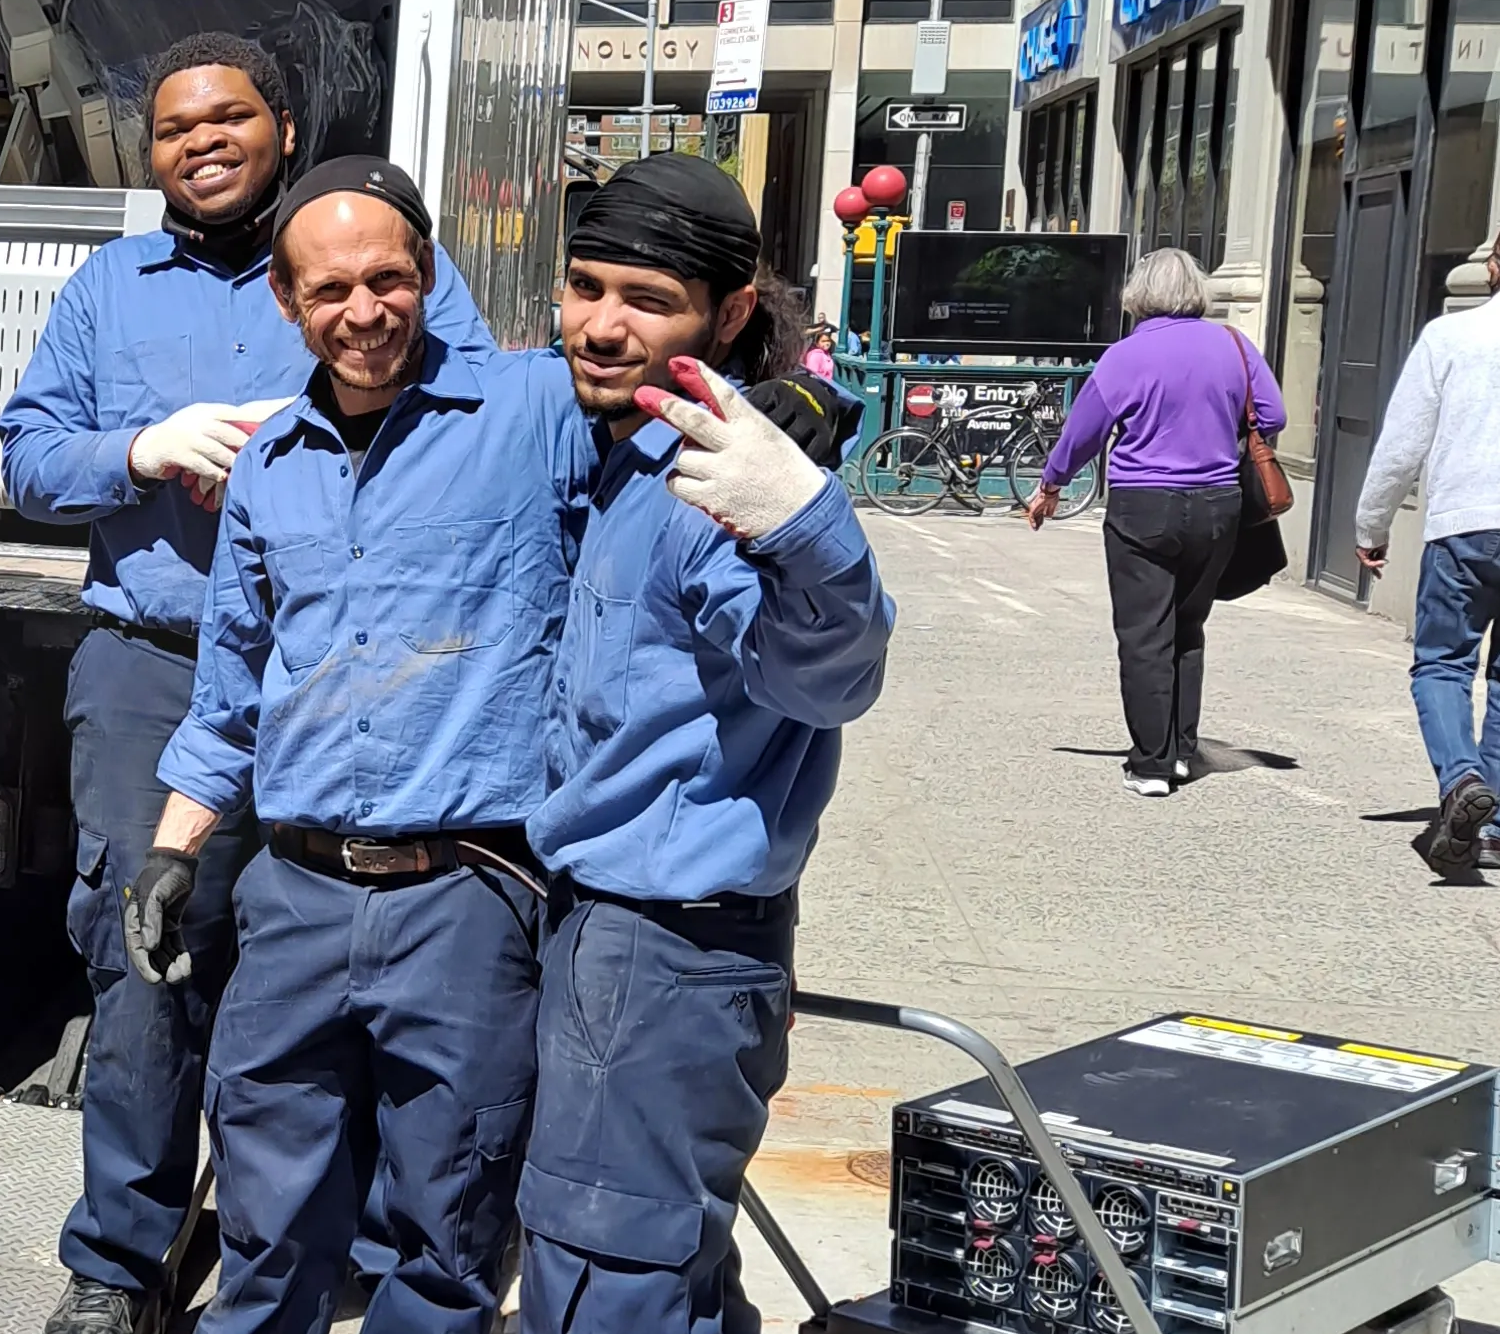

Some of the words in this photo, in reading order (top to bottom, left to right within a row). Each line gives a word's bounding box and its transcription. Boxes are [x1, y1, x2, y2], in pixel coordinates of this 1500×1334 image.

[722, 3, 732, 22] 3
[1020, 12, 1060, 82] CHASE
[709, 97, 745, 110] 103926
[899, 112, 921, 123] ONE
[932, 112, 954, 123] WAY
[942, 384, 968, 401] No
[974, 385, 1019, 405] Entry
[966, 419, 1012, 431] Avenue
